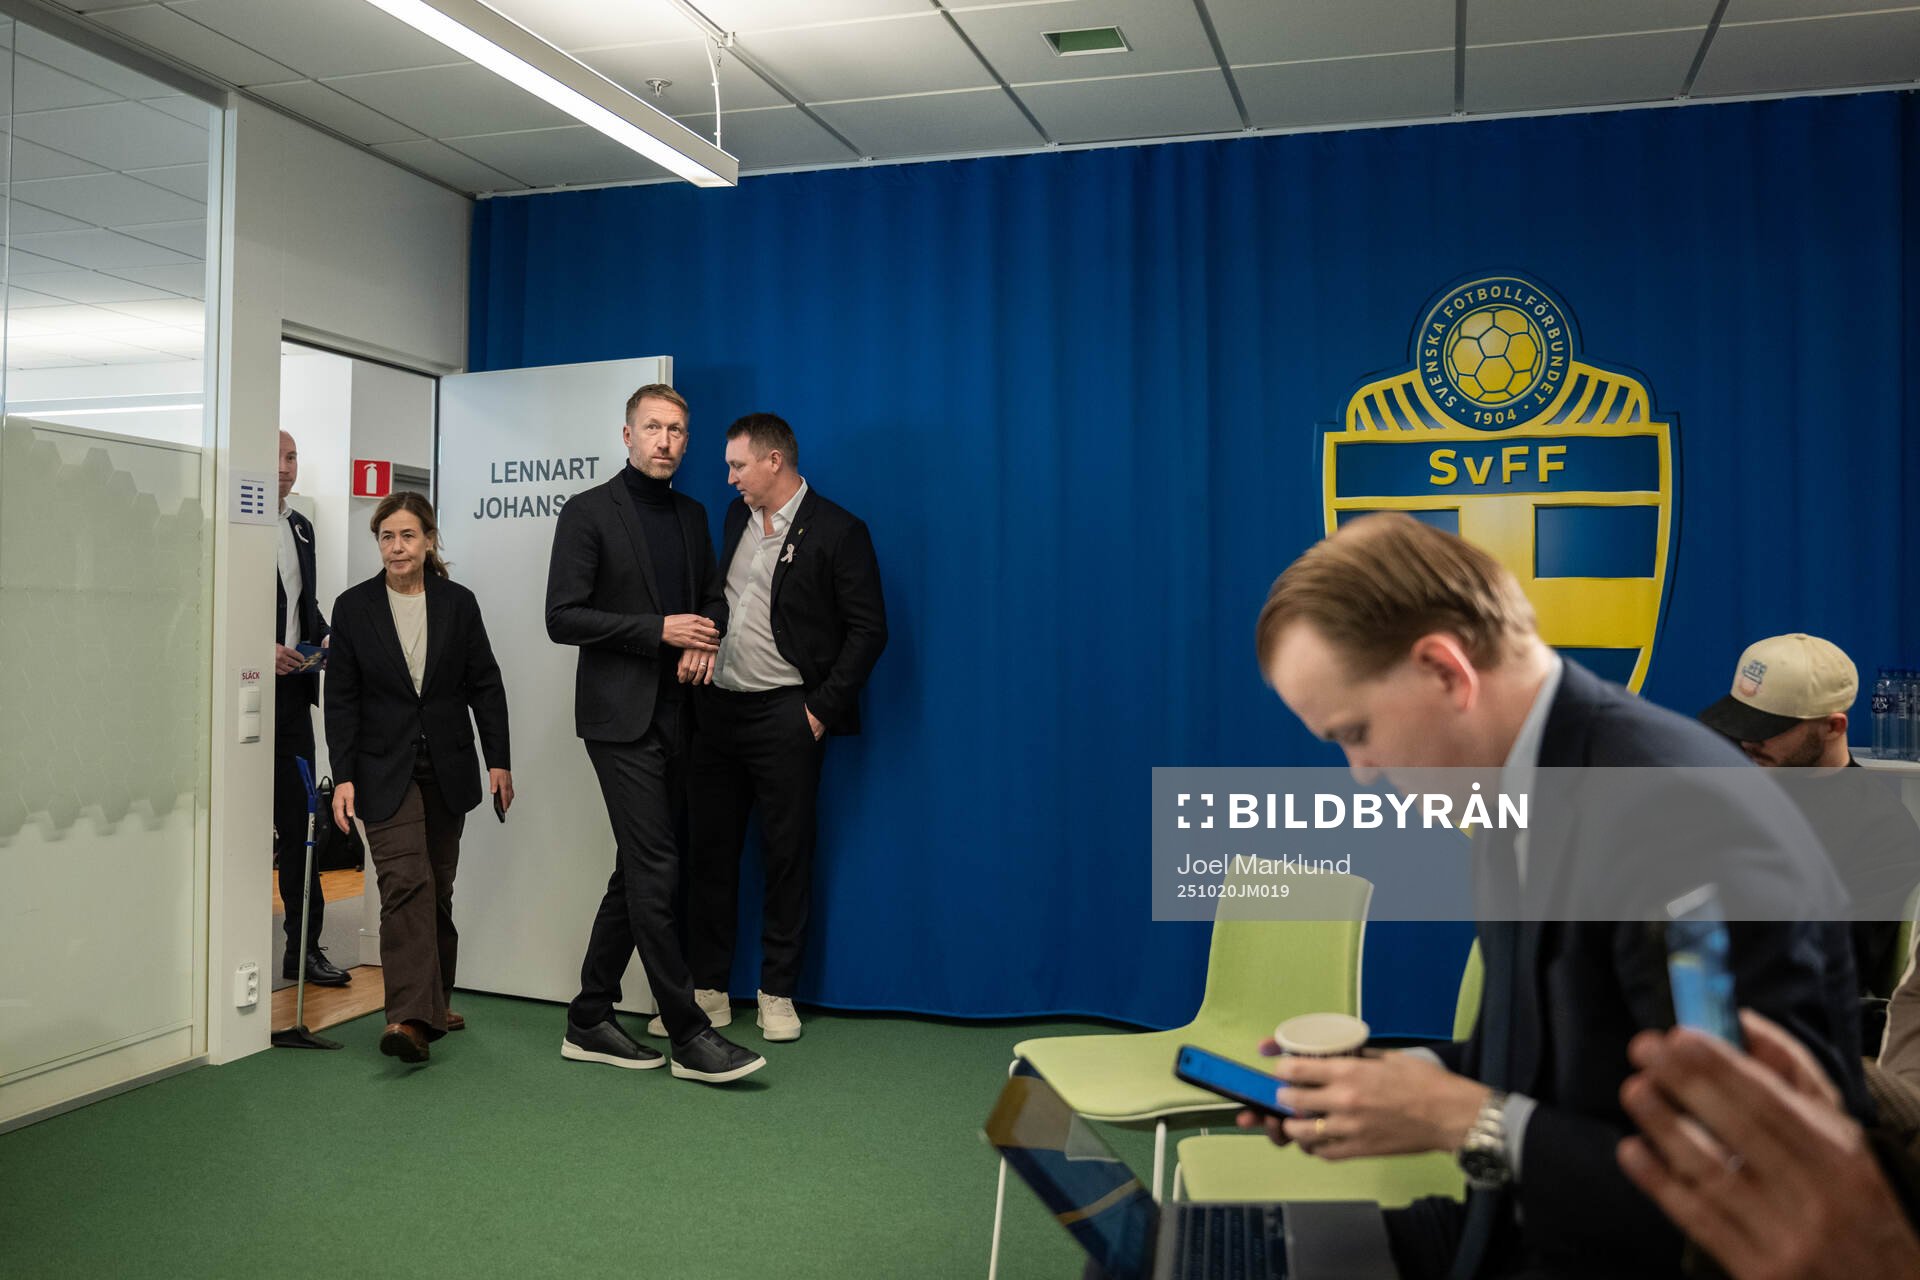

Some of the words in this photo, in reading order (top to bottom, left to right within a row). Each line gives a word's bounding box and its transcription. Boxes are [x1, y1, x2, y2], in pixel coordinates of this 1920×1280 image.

[1425, 322, 1457, 408] SVENSKA
[1443, 285, 1564, 405] FOTBOLLFÖRBUNDET
[1474, 408, 1517, 424] 1904
[491, 456, 600, 484] LENNART
[1429, 445, 1567, 486] SvFF
[473, 493, 577, 520] JOHANS
